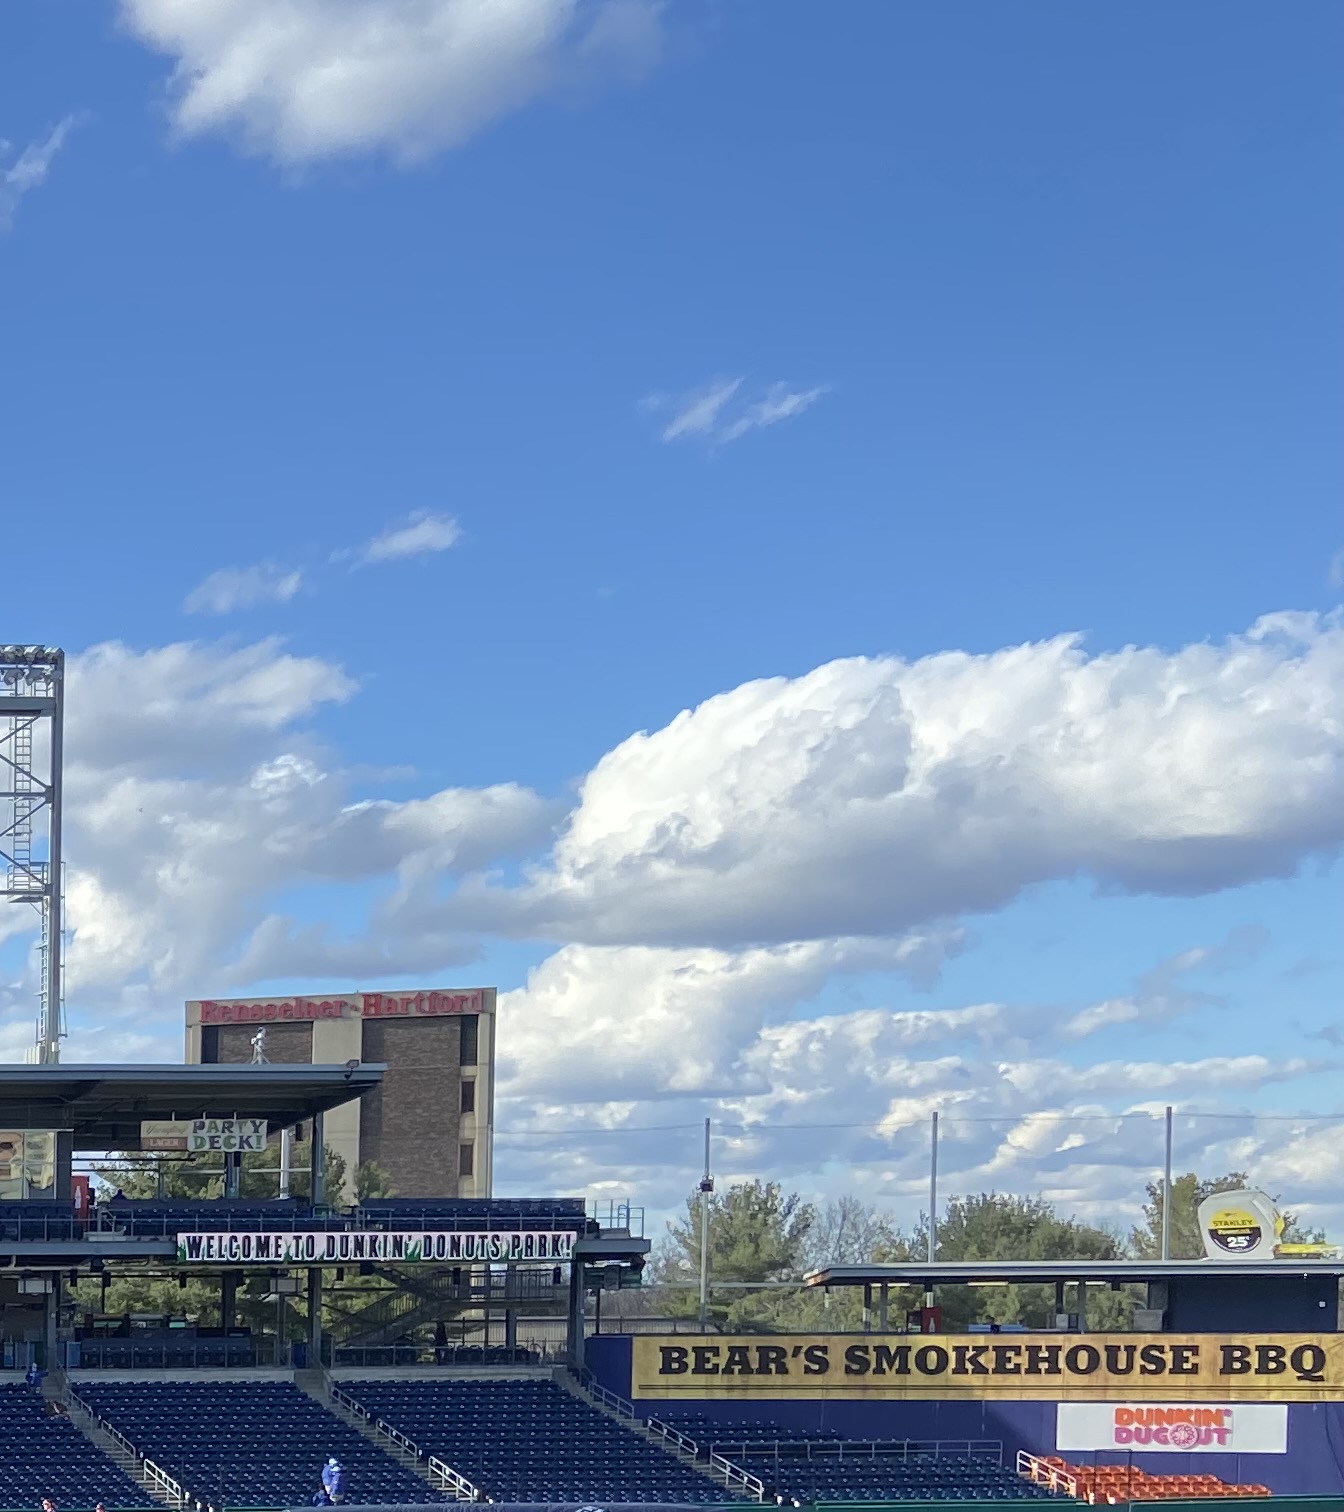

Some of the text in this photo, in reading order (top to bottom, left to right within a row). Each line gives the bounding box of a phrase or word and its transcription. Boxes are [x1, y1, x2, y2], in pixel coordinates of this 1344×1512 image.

[362, 991, 483, 1016] Hartford
[192, 1120, 265, 1134] PARTY
[193, 1135, 263, 1150] DECK!
[185, 1233, 573, 1262] WELCOME TO DUNKIN' DONUTS PARK!
[658, 1344, 1327, 1381] BEAR'S SMOKEHOUSE BBQ
